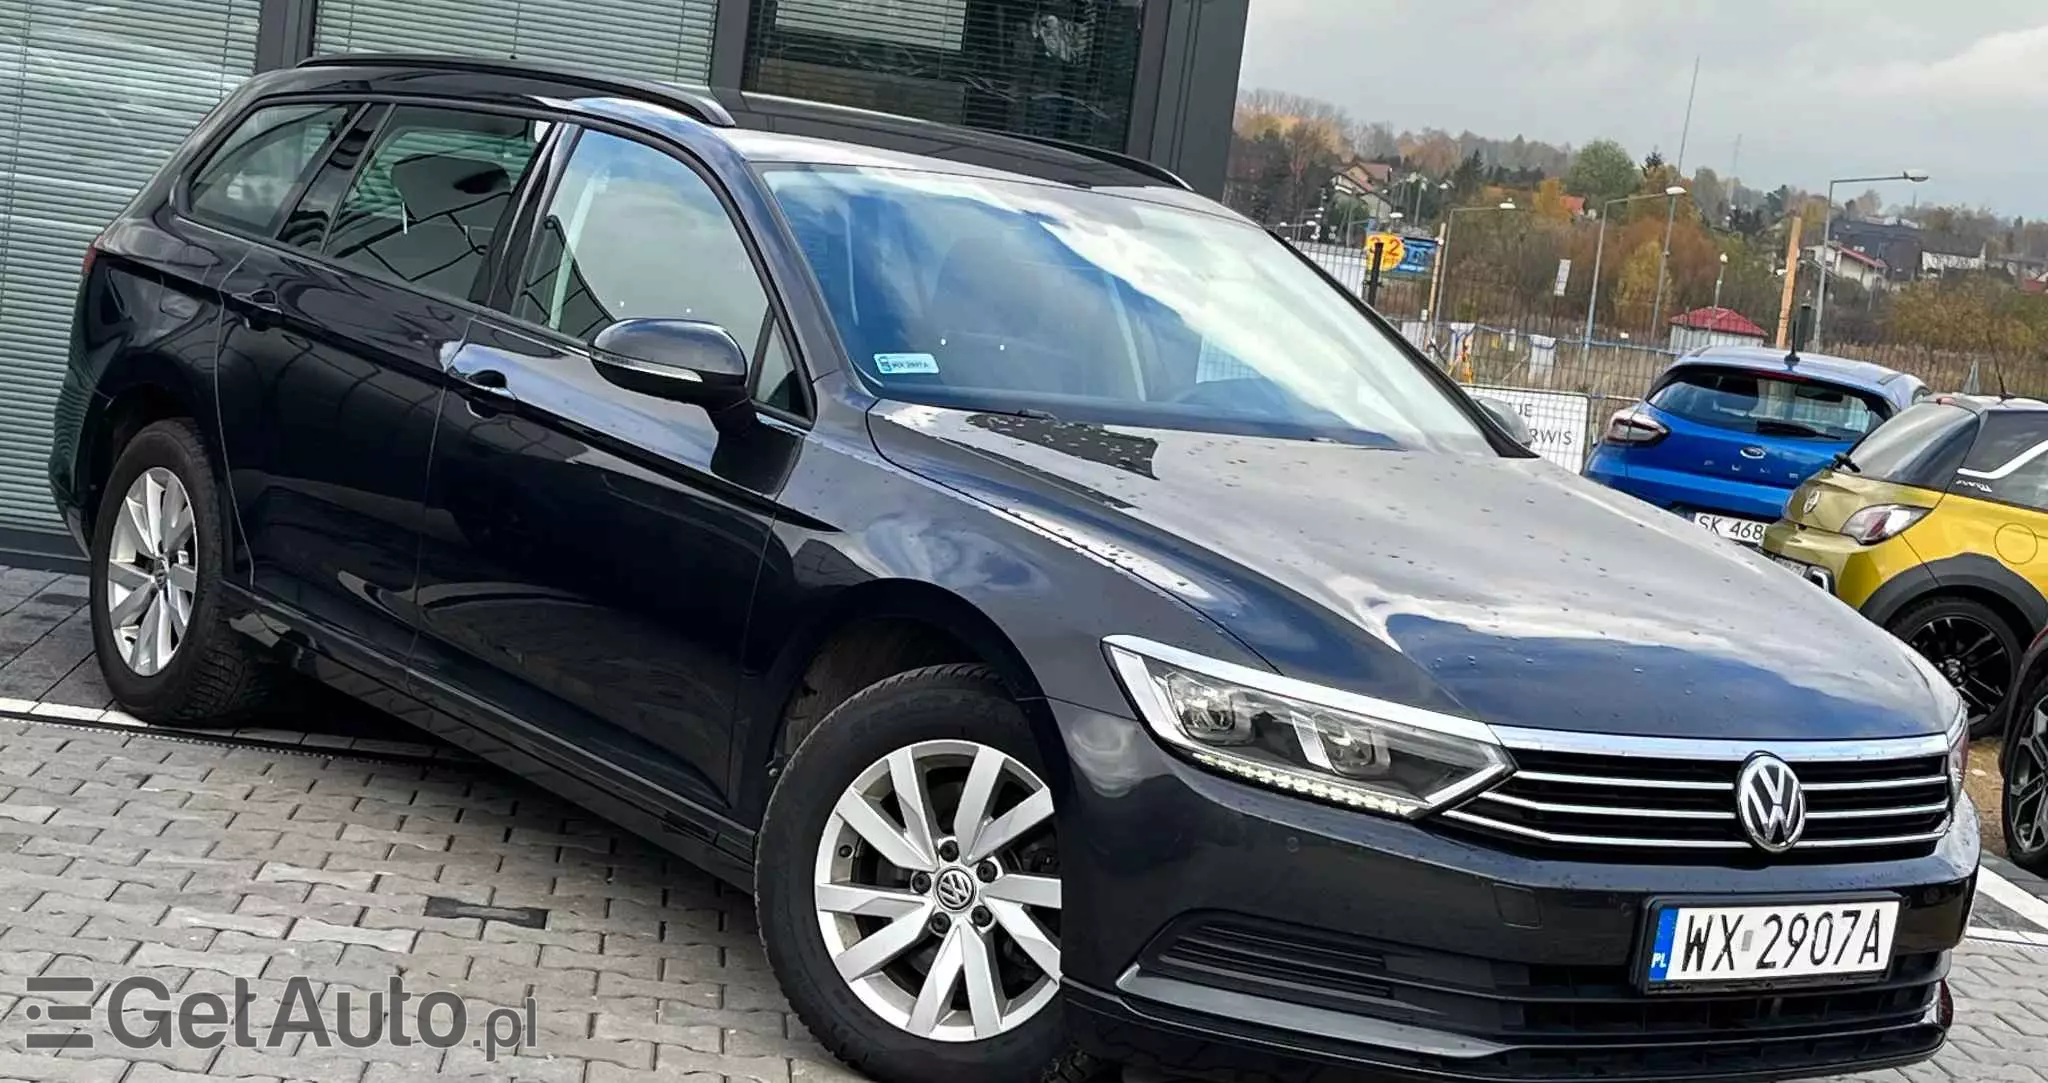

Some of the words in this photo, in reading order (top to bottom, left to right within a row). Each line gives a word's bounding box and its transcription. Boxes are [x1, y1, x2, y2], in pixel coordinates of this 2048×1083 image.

[1699, 515, 1723, 538] SK
[1681, 913, 1744, 972] WX
[1756, 908, 1881, 970] 2907A
[1651, 952, 1667, 969] PL
